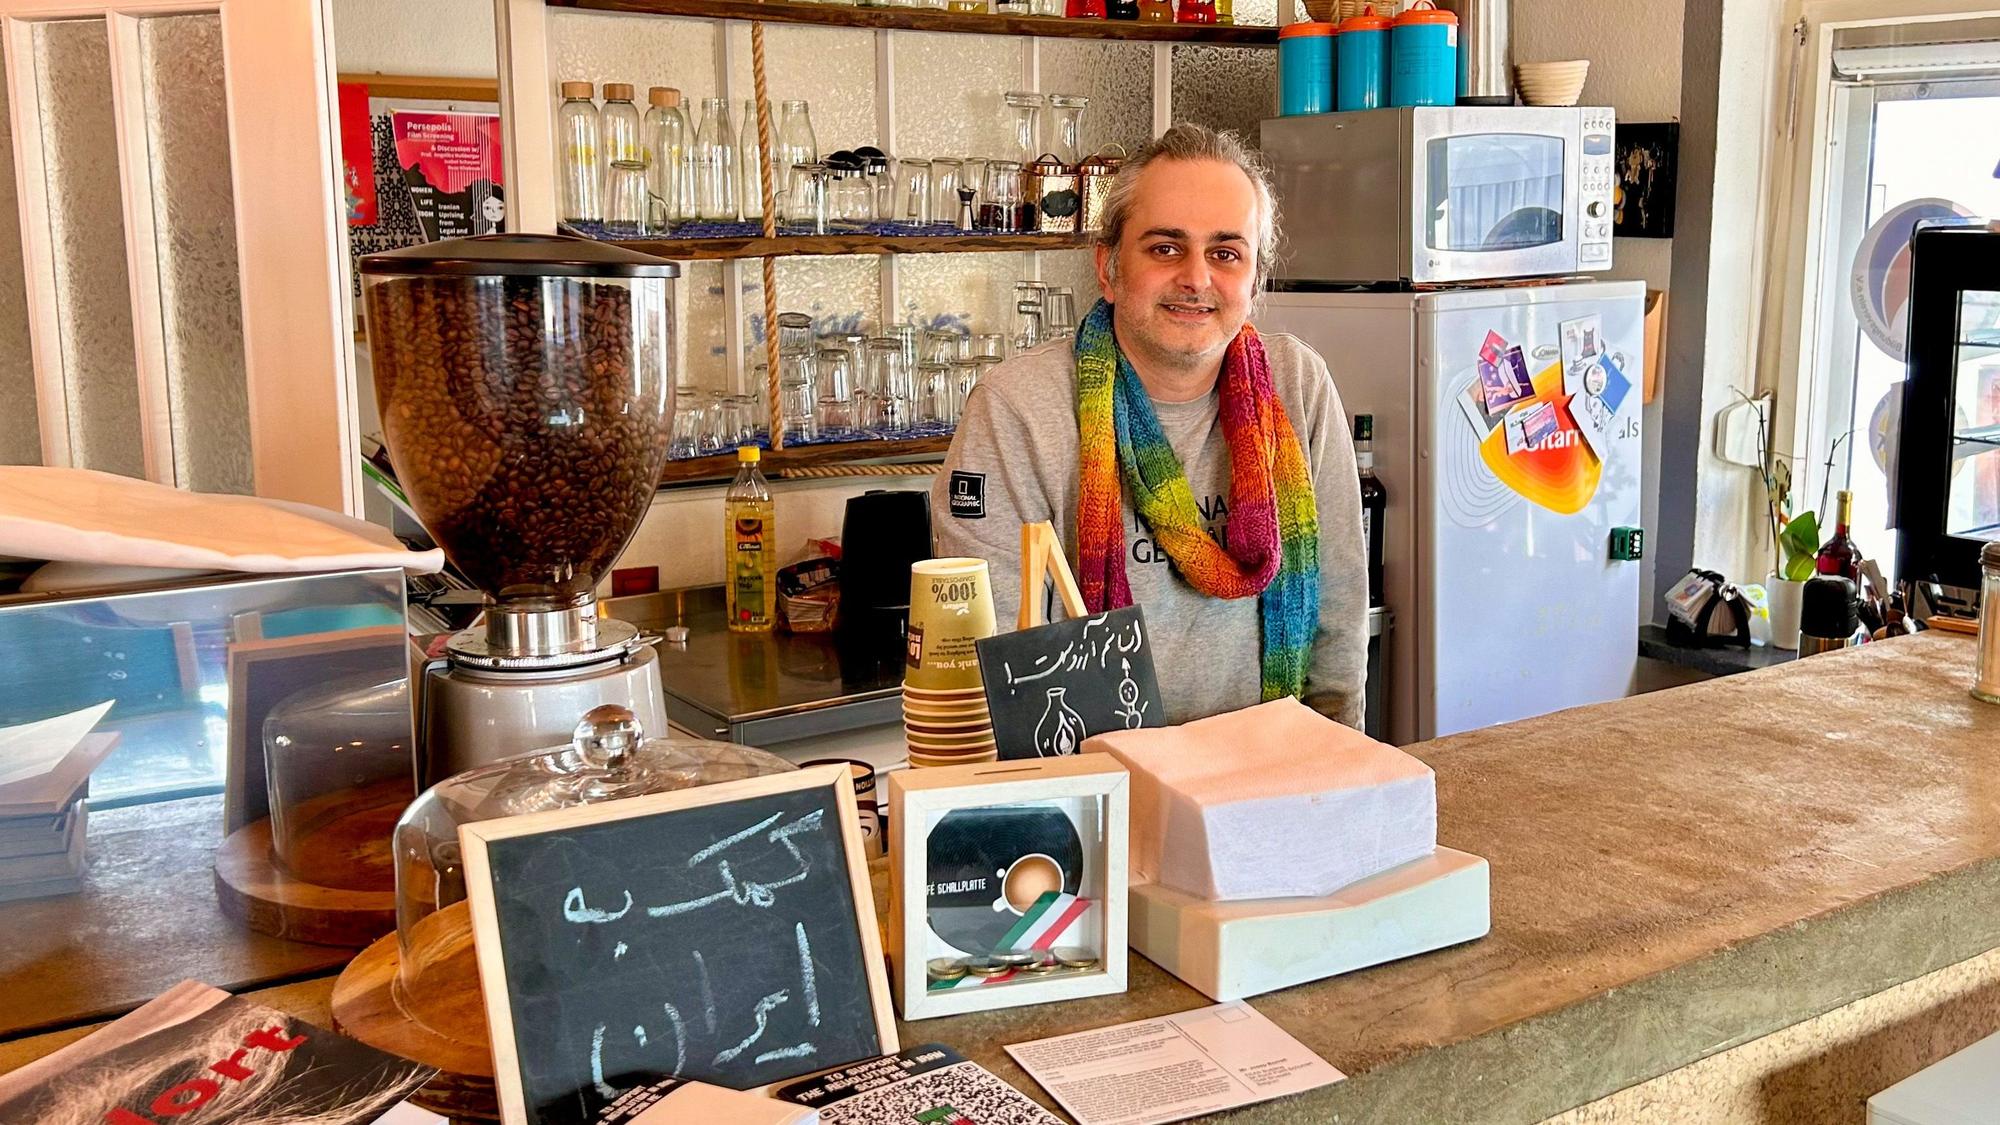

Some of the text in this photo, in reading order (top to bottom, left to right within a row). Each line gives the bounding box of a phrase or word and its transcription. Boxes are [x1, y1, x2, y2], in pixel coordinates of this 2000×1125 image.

[407, 121, 452, 132] Persepolis
[423, 132, 455, 141] Screening
[437, 144, 471, 152] Discussion
[410, 186, 433, 194] WOMEN
[420, 198, 433, 206] LIFE
[438, 212, 464, 220] Uprising
[440, 227, 456, 235] Legal
[931, 582, 978, 603] 100%
[958, 659, 979, 670] ank
[926, 877, 987, 897] FÉ SCHALLPLATTE
[824, 1054, 902, 1083] TO SUPPORT
[105, 1026, 309, 1125] ort
[796, 1050, 946, 1102] THE REVOLUTION IN IRAN
[853, 1069, 911, 1093] SCAN ME
